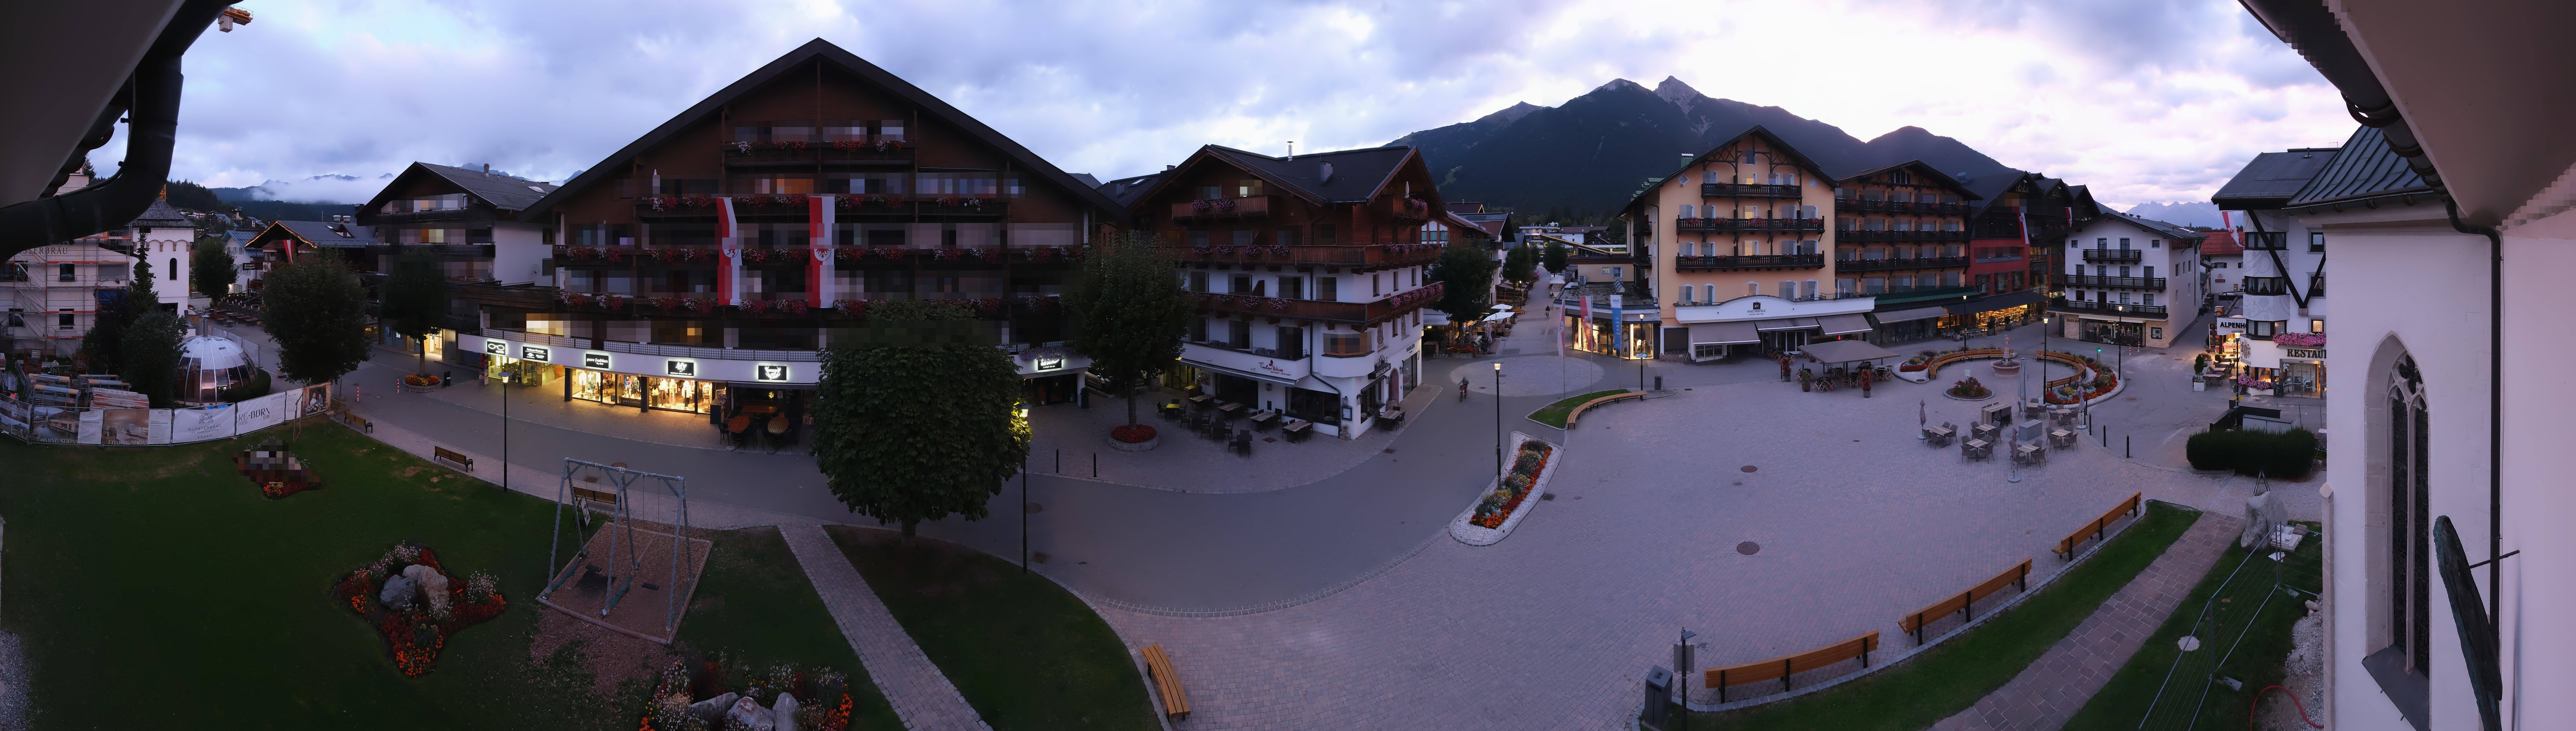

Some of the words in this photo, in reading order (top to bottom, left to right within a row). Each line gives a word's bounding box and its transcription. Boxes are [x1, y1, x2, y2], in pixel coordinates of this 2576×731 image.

[1406, 343, 1415, 352] SAILER
[2240, 356, 2251, 365] Kaltschmid
[1376, 365, 1390, 378] RESTAURANT
